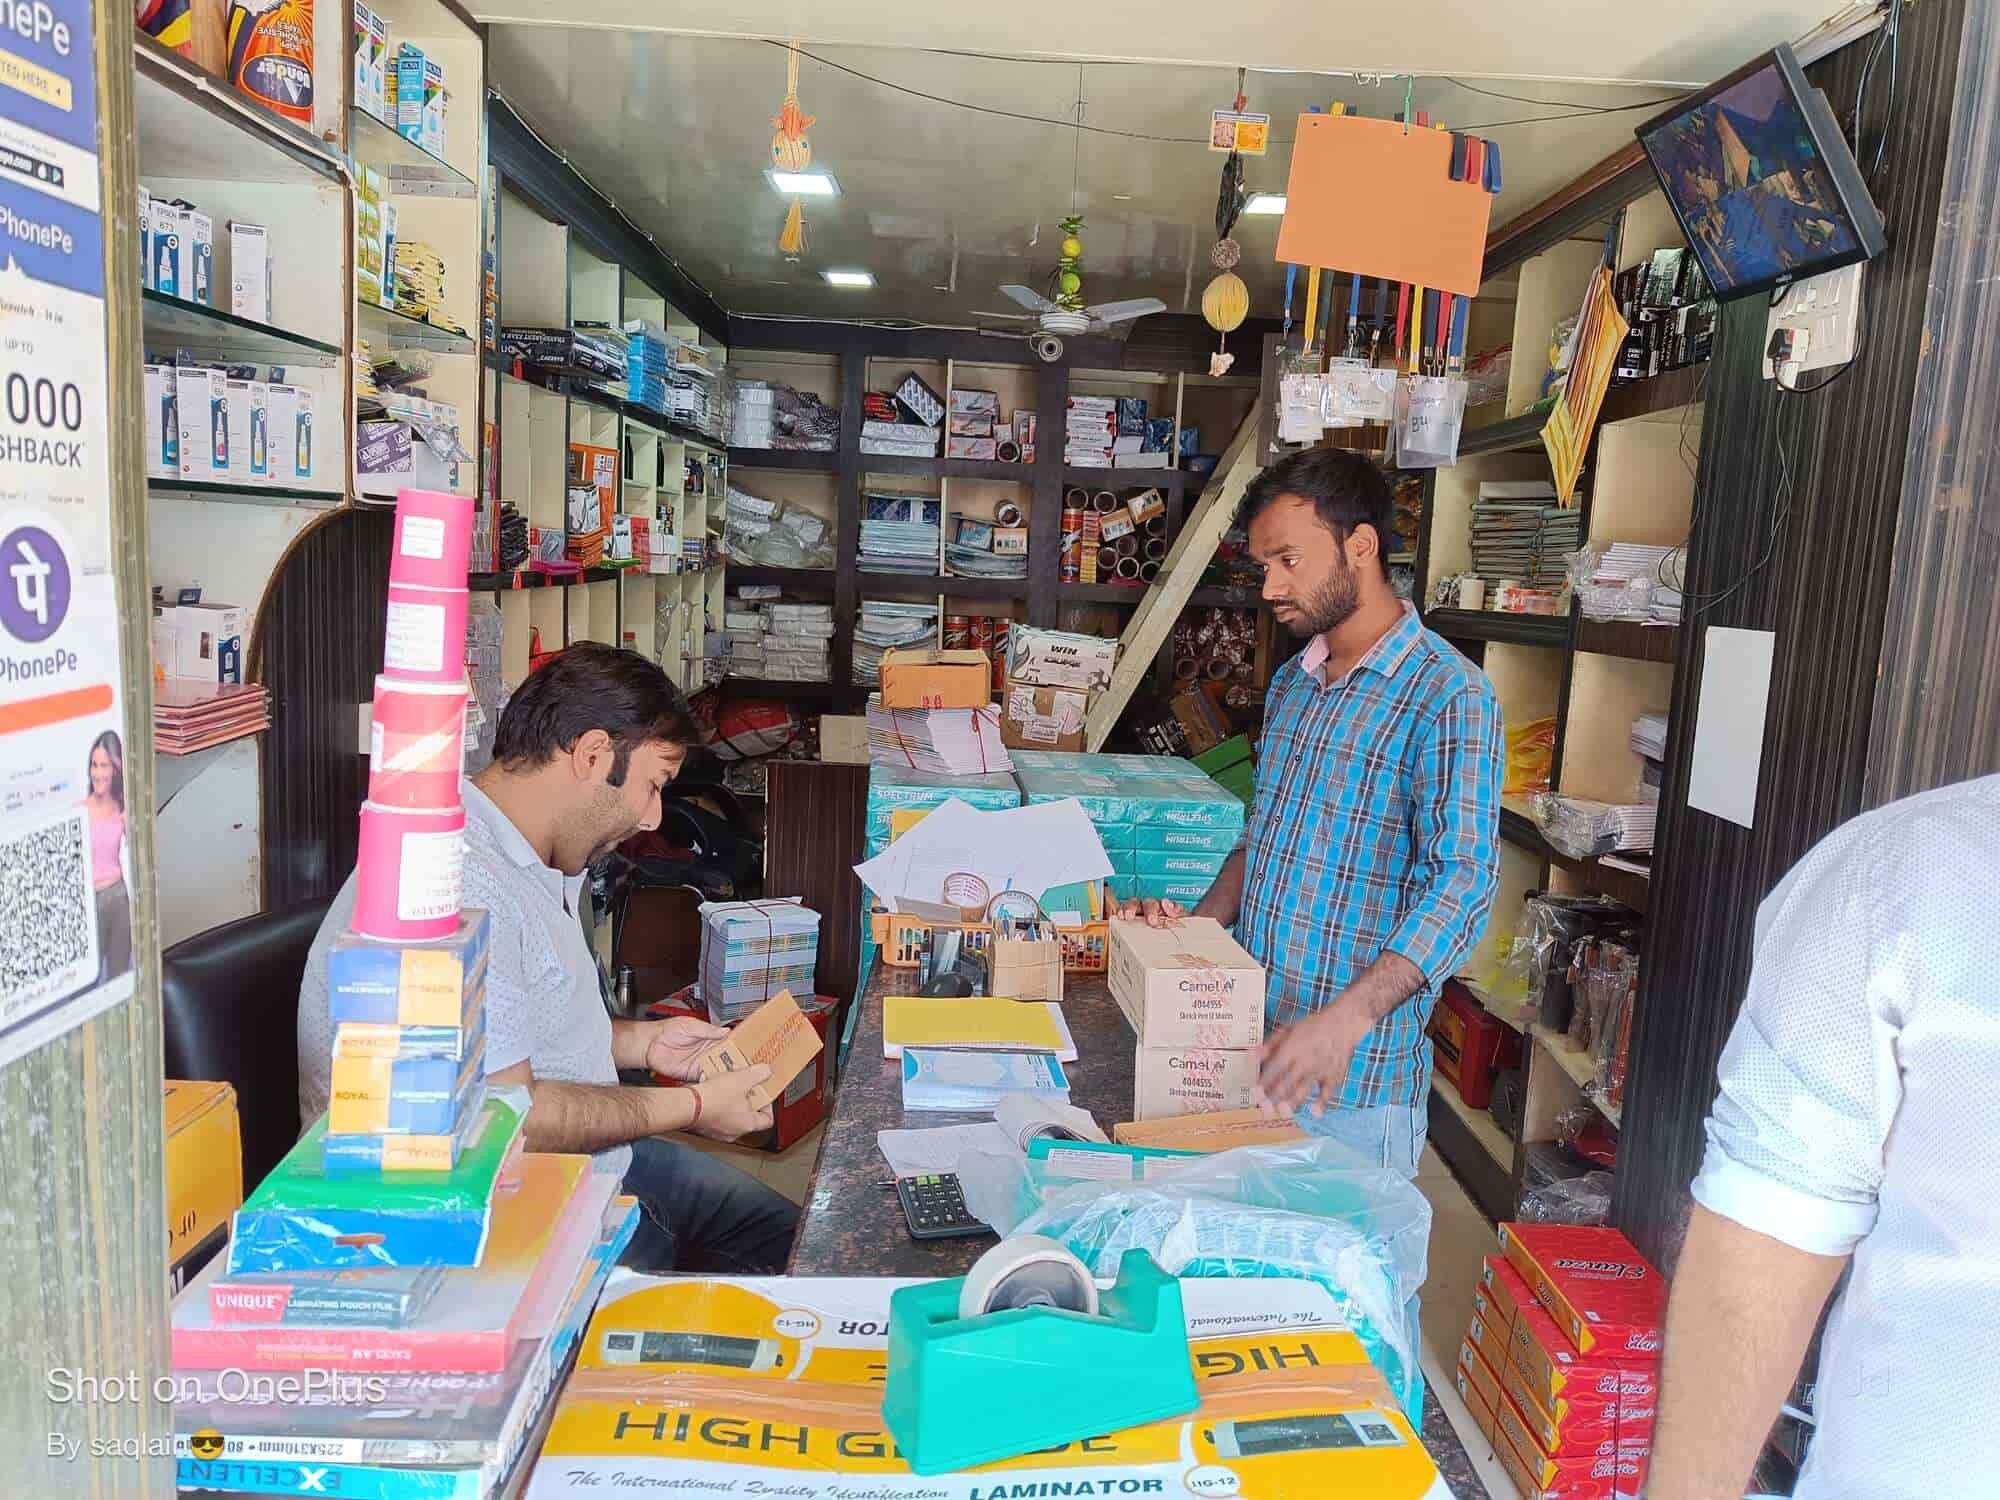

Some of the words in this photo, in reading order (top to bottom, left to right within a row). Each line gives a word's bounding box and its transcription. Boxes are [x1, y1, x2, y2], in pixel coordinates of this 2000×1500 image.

[1050, 644, 1079, 656] WIN
[1165, 835, 1213, 848] SPECTRUM
[1165, 861, 1213, 873] SPECTRUM
[1179, 980, 1220, 993] Camel
[1168, 1056, 1209, 1071] Camel
[335, 1090, 369, 1100] ROYAL
[215, 1294, 277, 1310] UNIQUE
[1195, 1343, 1320, 1378] HIG
[613, 1411, 808, 1455] HIGH
[566, 1470, 602, 1487] The
[610, 1471, 738, 1492] International
[968, 1477, 1164, 1500] LAMINATOR
